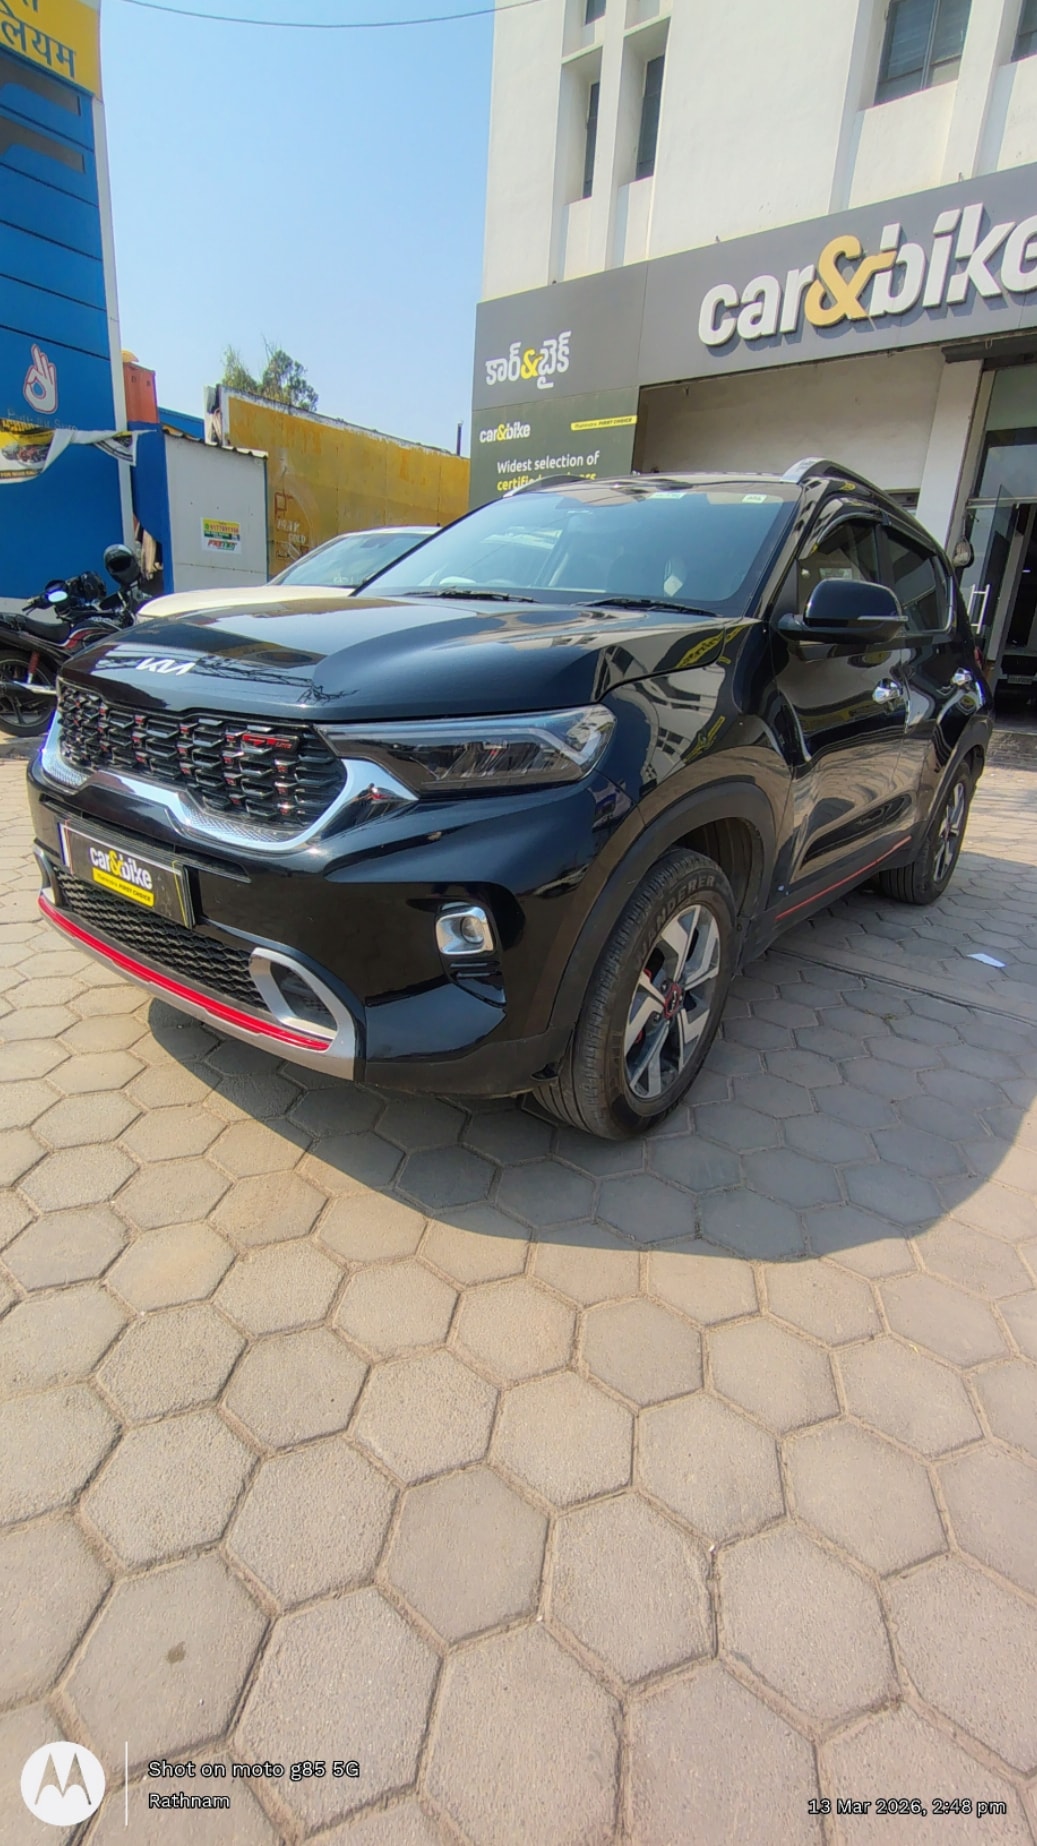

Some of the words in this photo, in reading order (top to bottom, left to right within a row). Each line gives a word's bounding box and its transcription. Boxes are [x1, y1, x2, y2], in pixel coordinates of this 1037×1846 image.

[479, 422, 531, 443] car&bike
[497, 459, 532, 474] Widest
[534, 454, 584, 470] selection
[586, 450, 600, 465] of
[89, 846, 153, 890] car&bike
